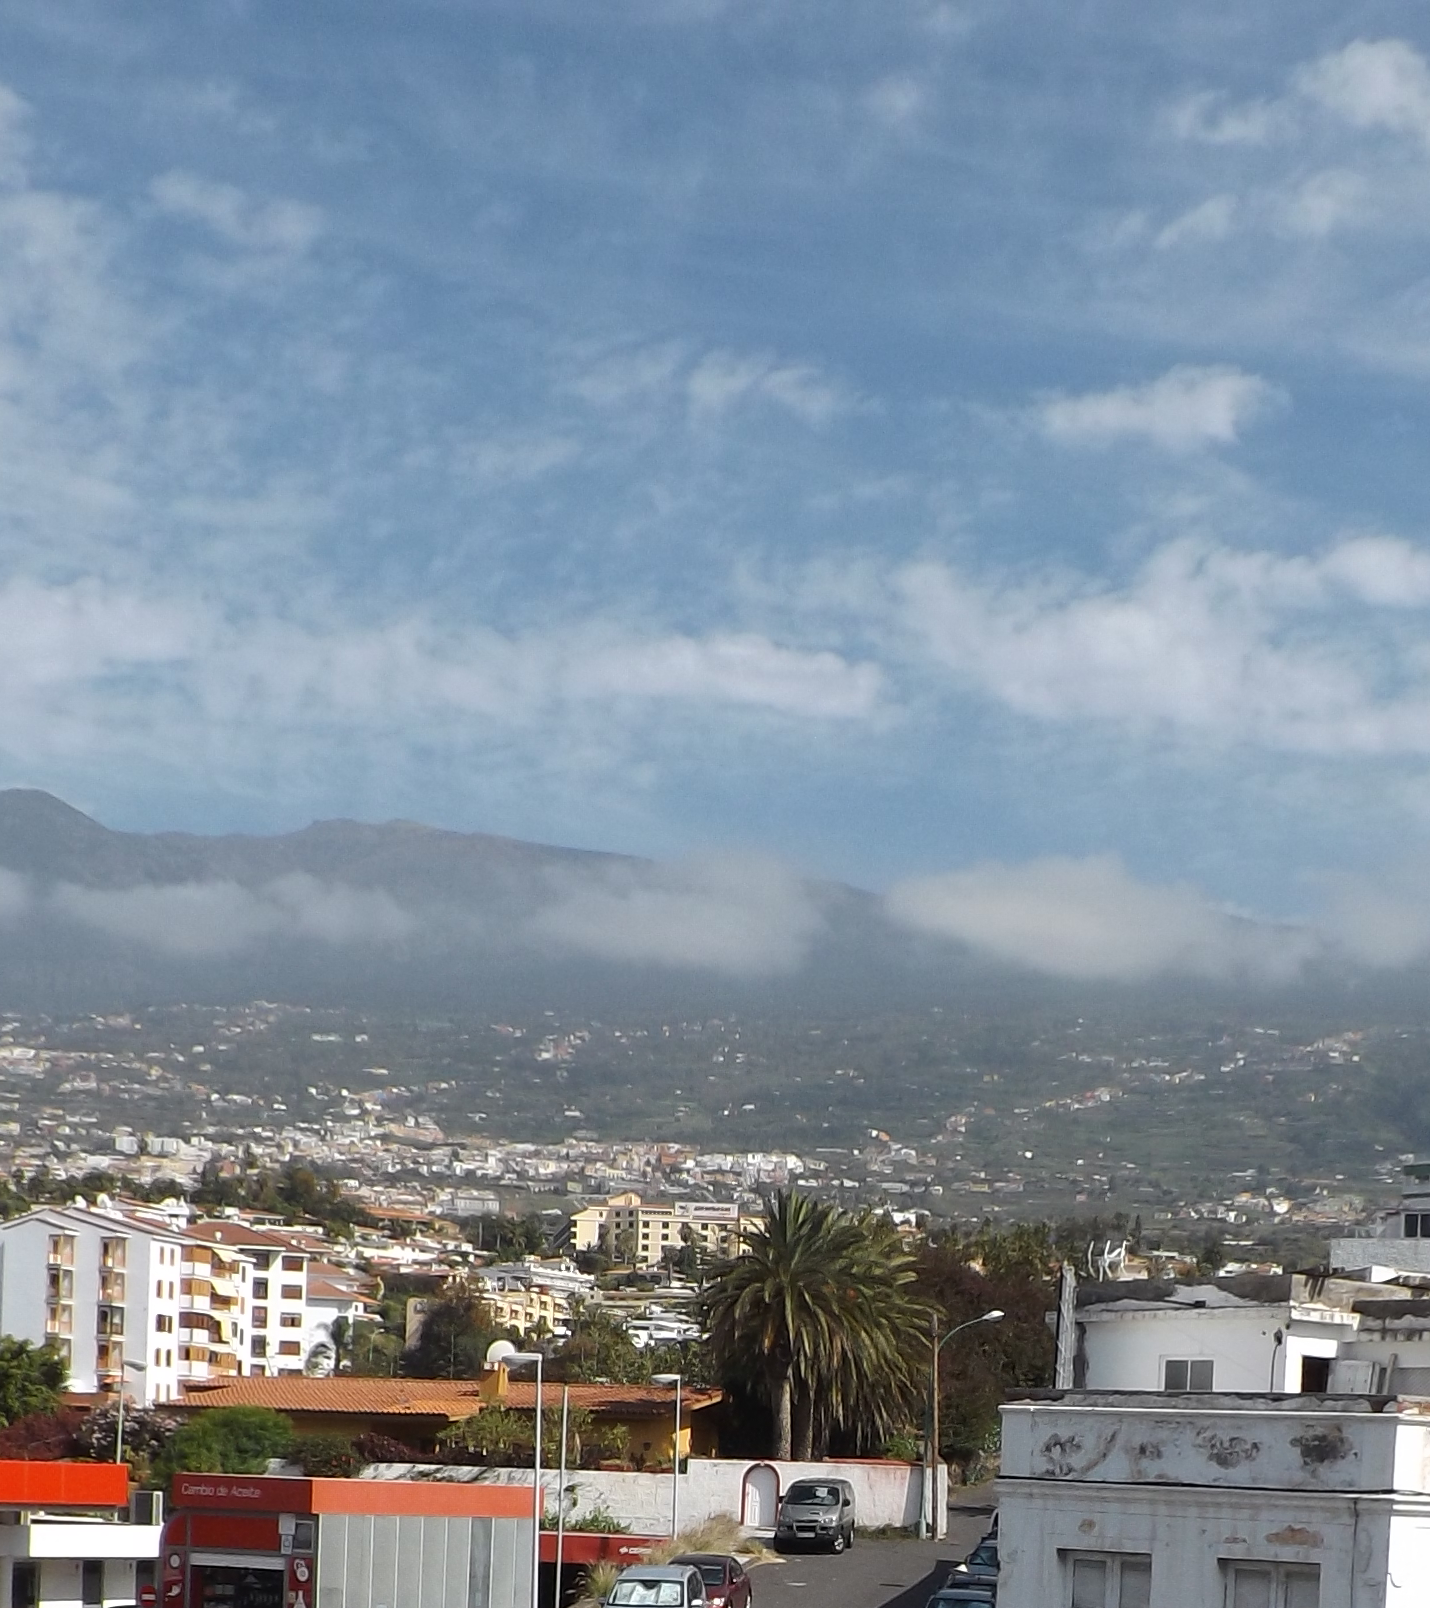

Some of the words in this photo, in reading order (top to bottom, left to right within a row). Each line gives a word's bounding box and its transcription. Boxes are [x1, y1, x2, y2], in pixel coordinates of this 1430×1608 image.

[182, 1483, 214, 1496] Cambio
[216, 1486, 228, 1497] de
[230, 1486, 261, 1498] Aceite
